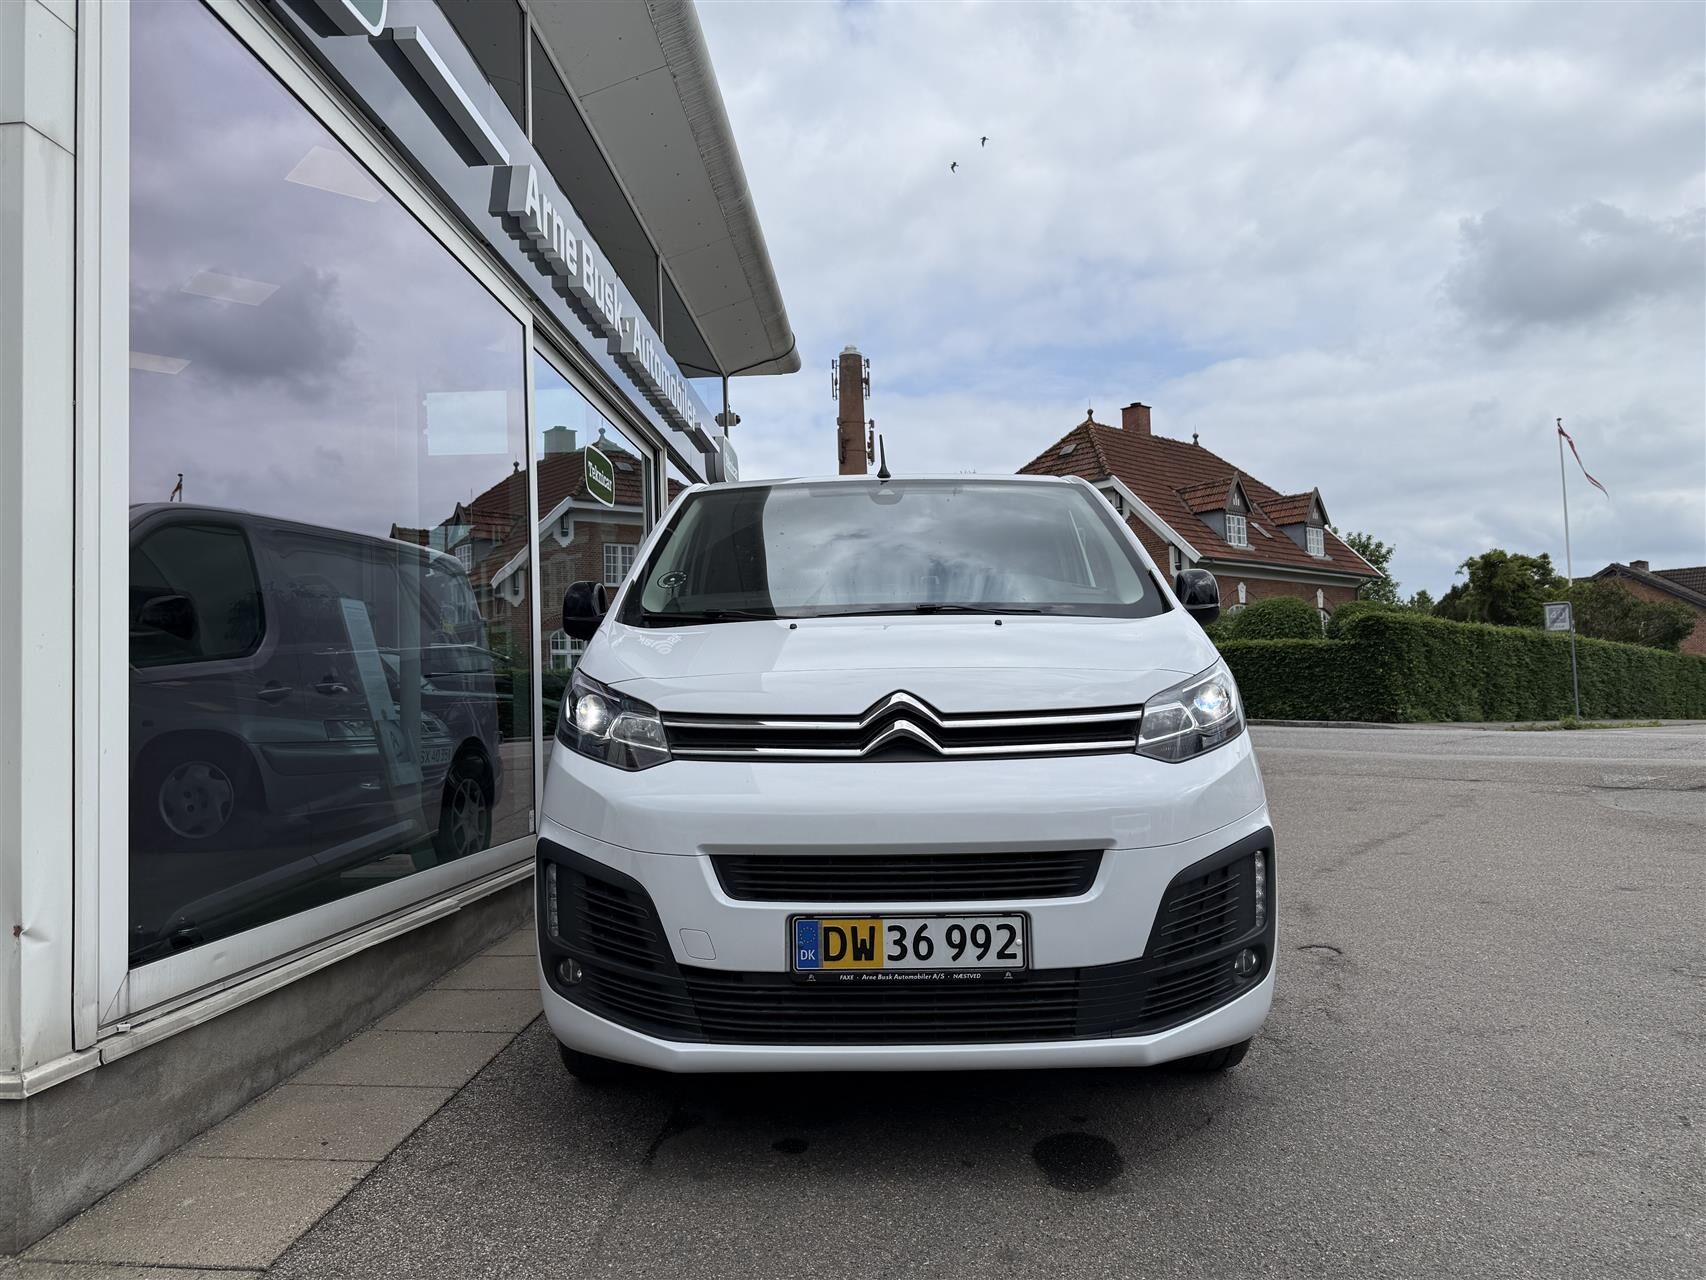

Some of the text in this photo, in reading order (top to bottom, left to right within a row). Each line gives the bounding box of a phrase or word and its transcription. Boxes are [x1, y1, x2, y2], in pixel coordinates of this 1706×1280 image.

[525, 164, 696, 432] Arne Busk Automobiler
[587, 460, 612, 492] Teknicar
[800, 950, 816, 961] DK
[823, 923, 1018, 962] DW 36 992
[893, 972, 932, 981] Automobiler
[932, 972, 945, 980] A/S
